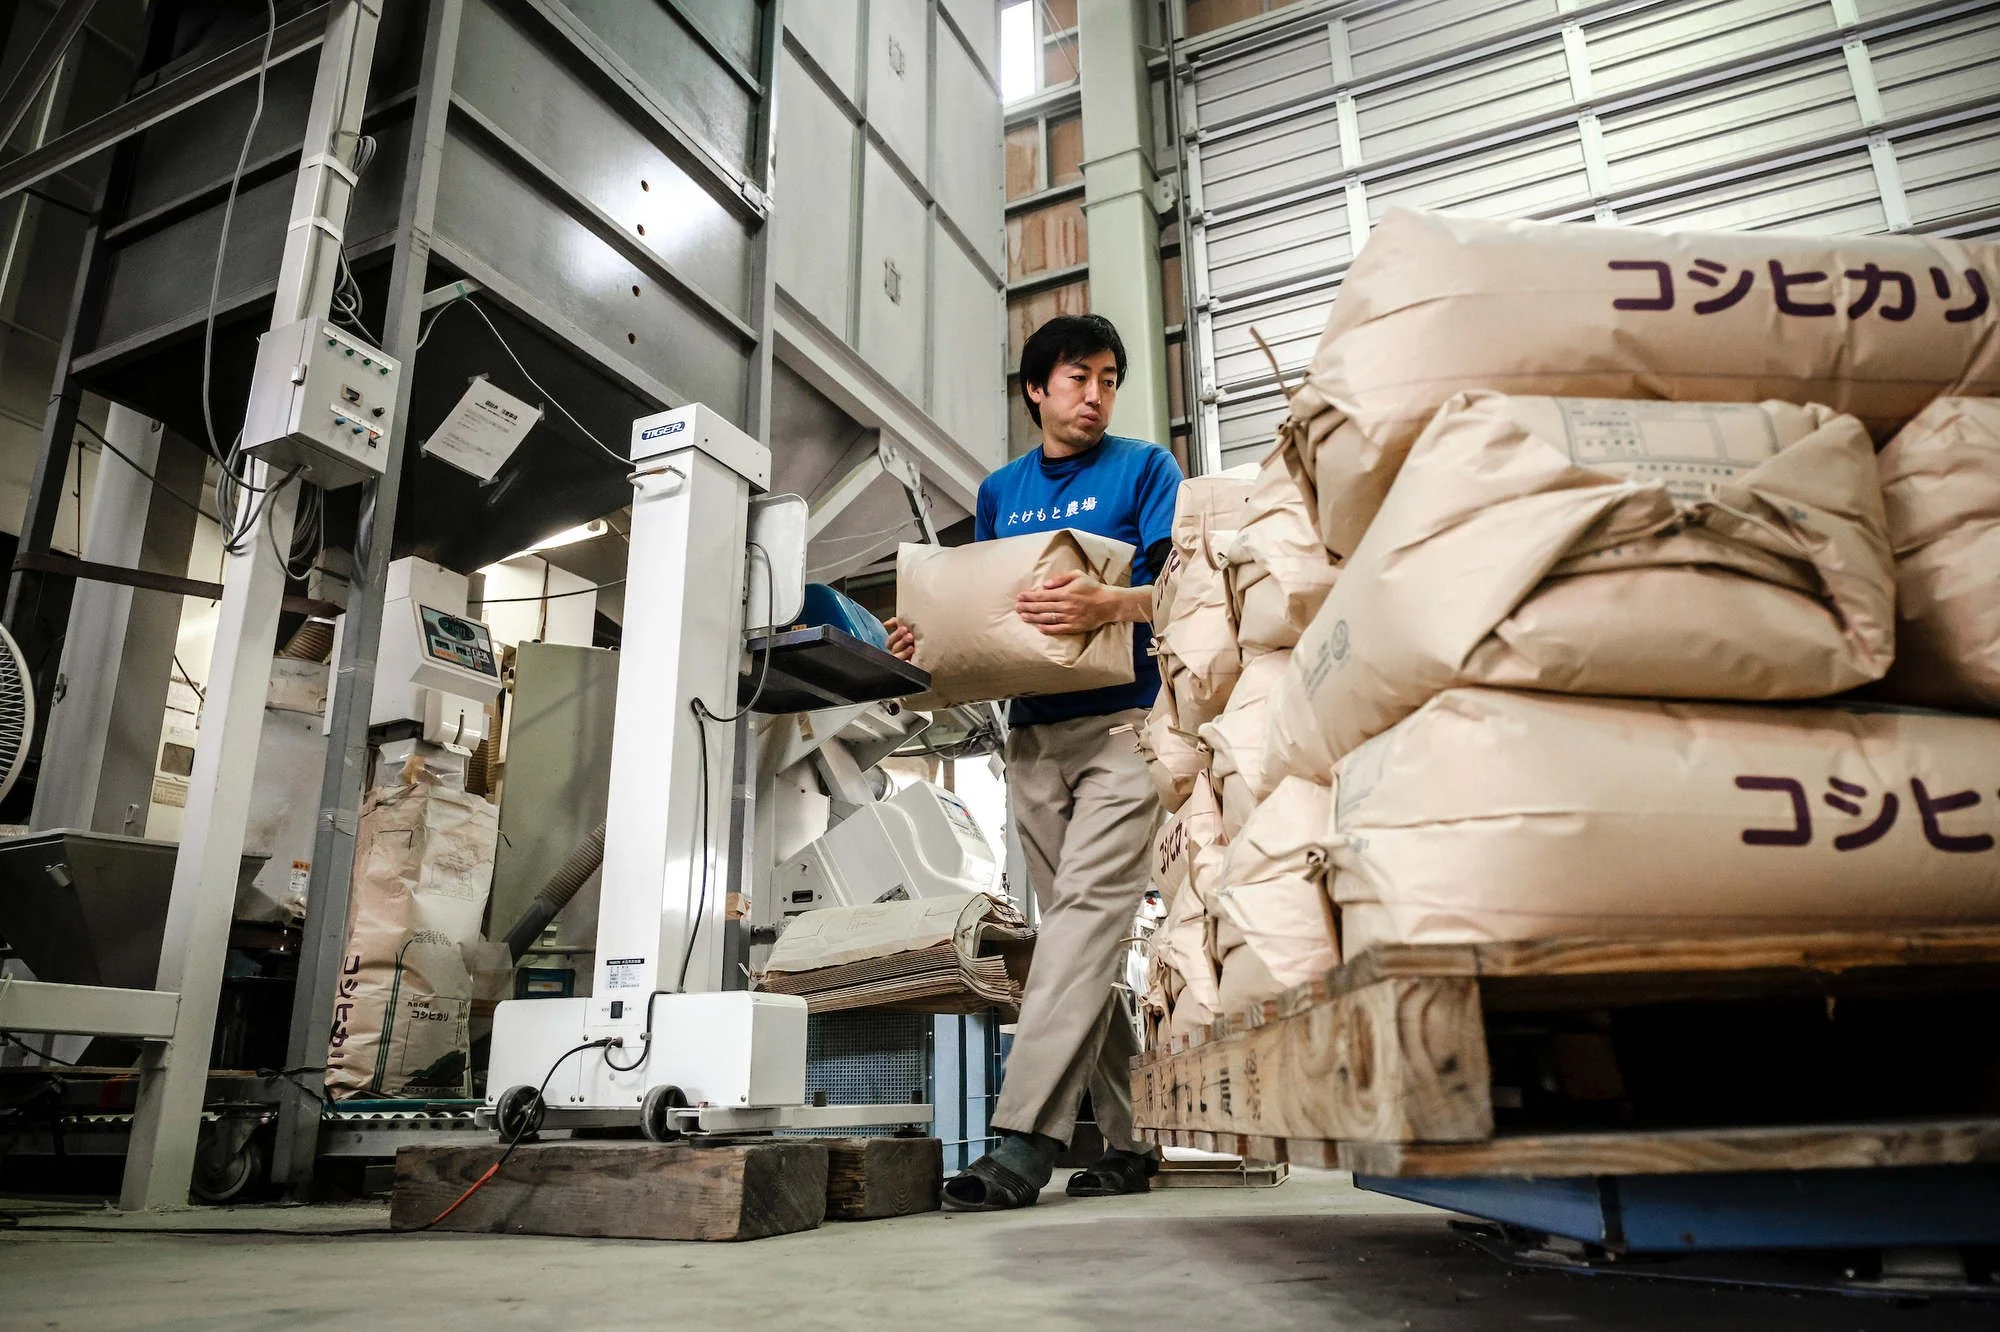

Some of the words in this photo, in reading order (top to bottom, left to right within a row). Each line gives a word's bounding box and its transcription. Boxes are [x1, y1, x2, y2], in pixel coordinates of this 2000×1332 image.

[1607, 258, 1990, 323] コシヒカリ
[643, 422, 683, 440] TIGER
[1007, 496, 1098, 526] たけもと農場
[1734, 775, 2000, 853] コシヒ
[411, 1010, 449, 1022] コシヒカリ
